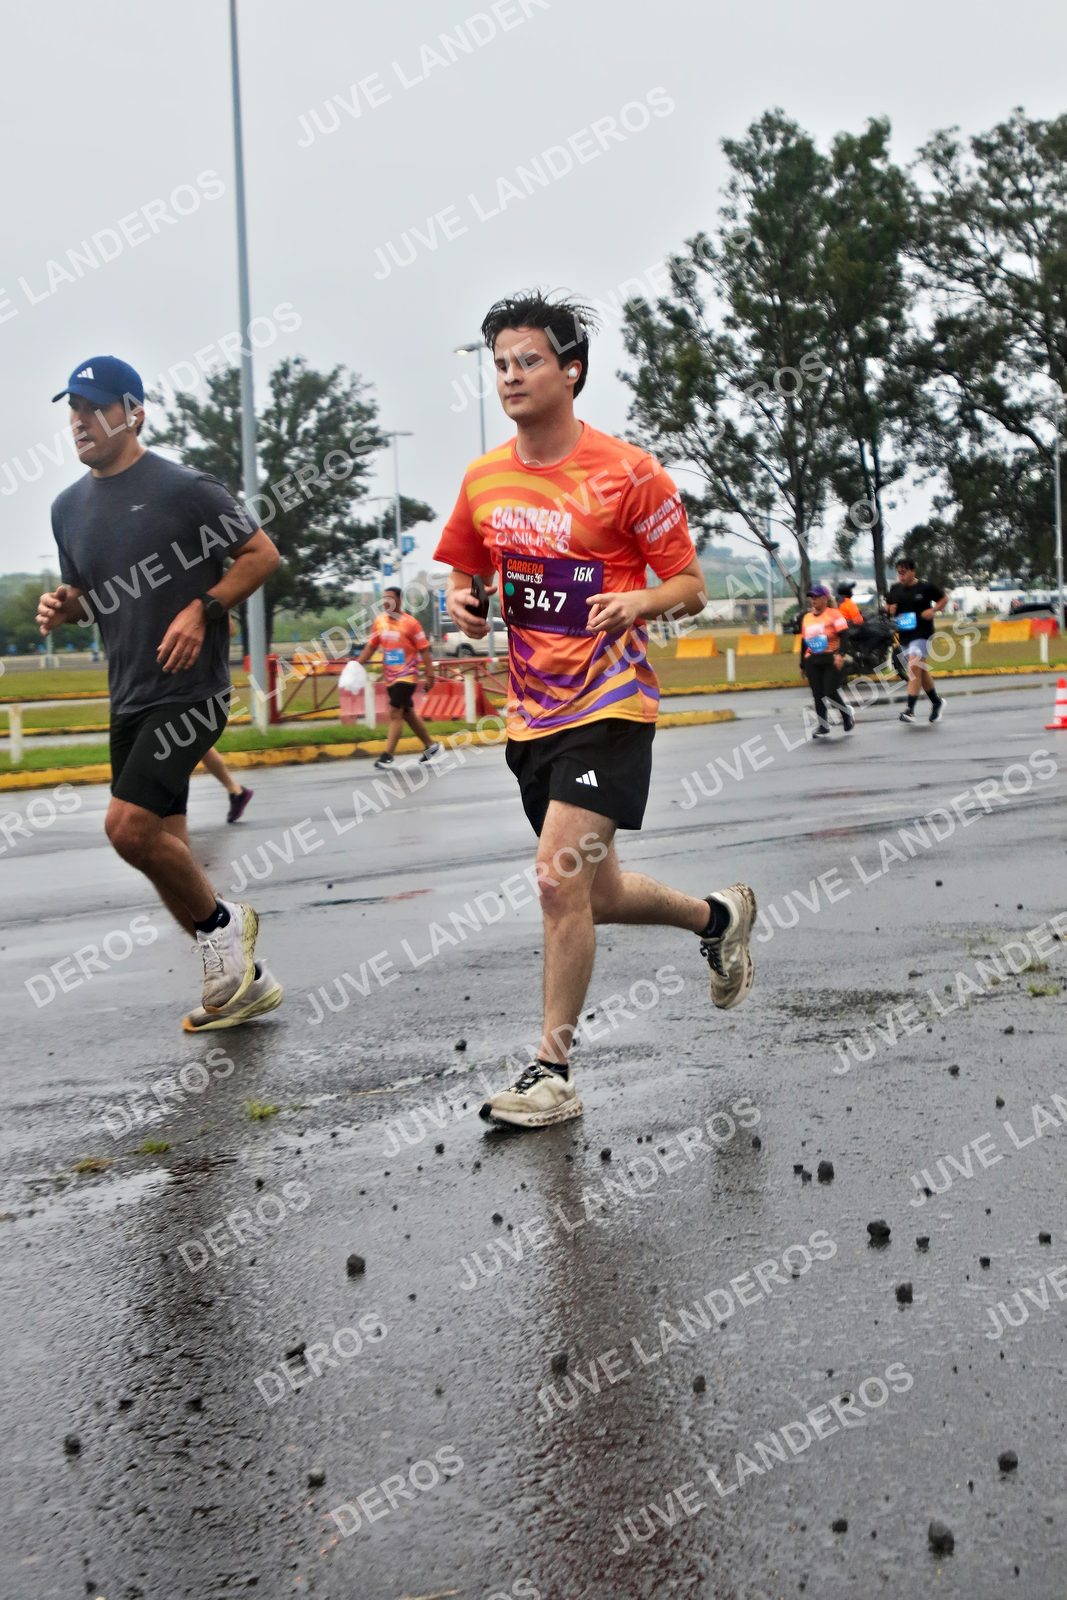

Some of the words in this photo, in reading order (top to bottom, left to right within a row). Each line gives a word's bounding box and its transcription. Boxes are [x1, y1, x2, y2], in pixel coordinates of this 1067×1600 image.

[492, 505, 572, 535] CARRERA
[507, 558, 544, 574] CARRERA
[523, 587, 567, 613] 347
